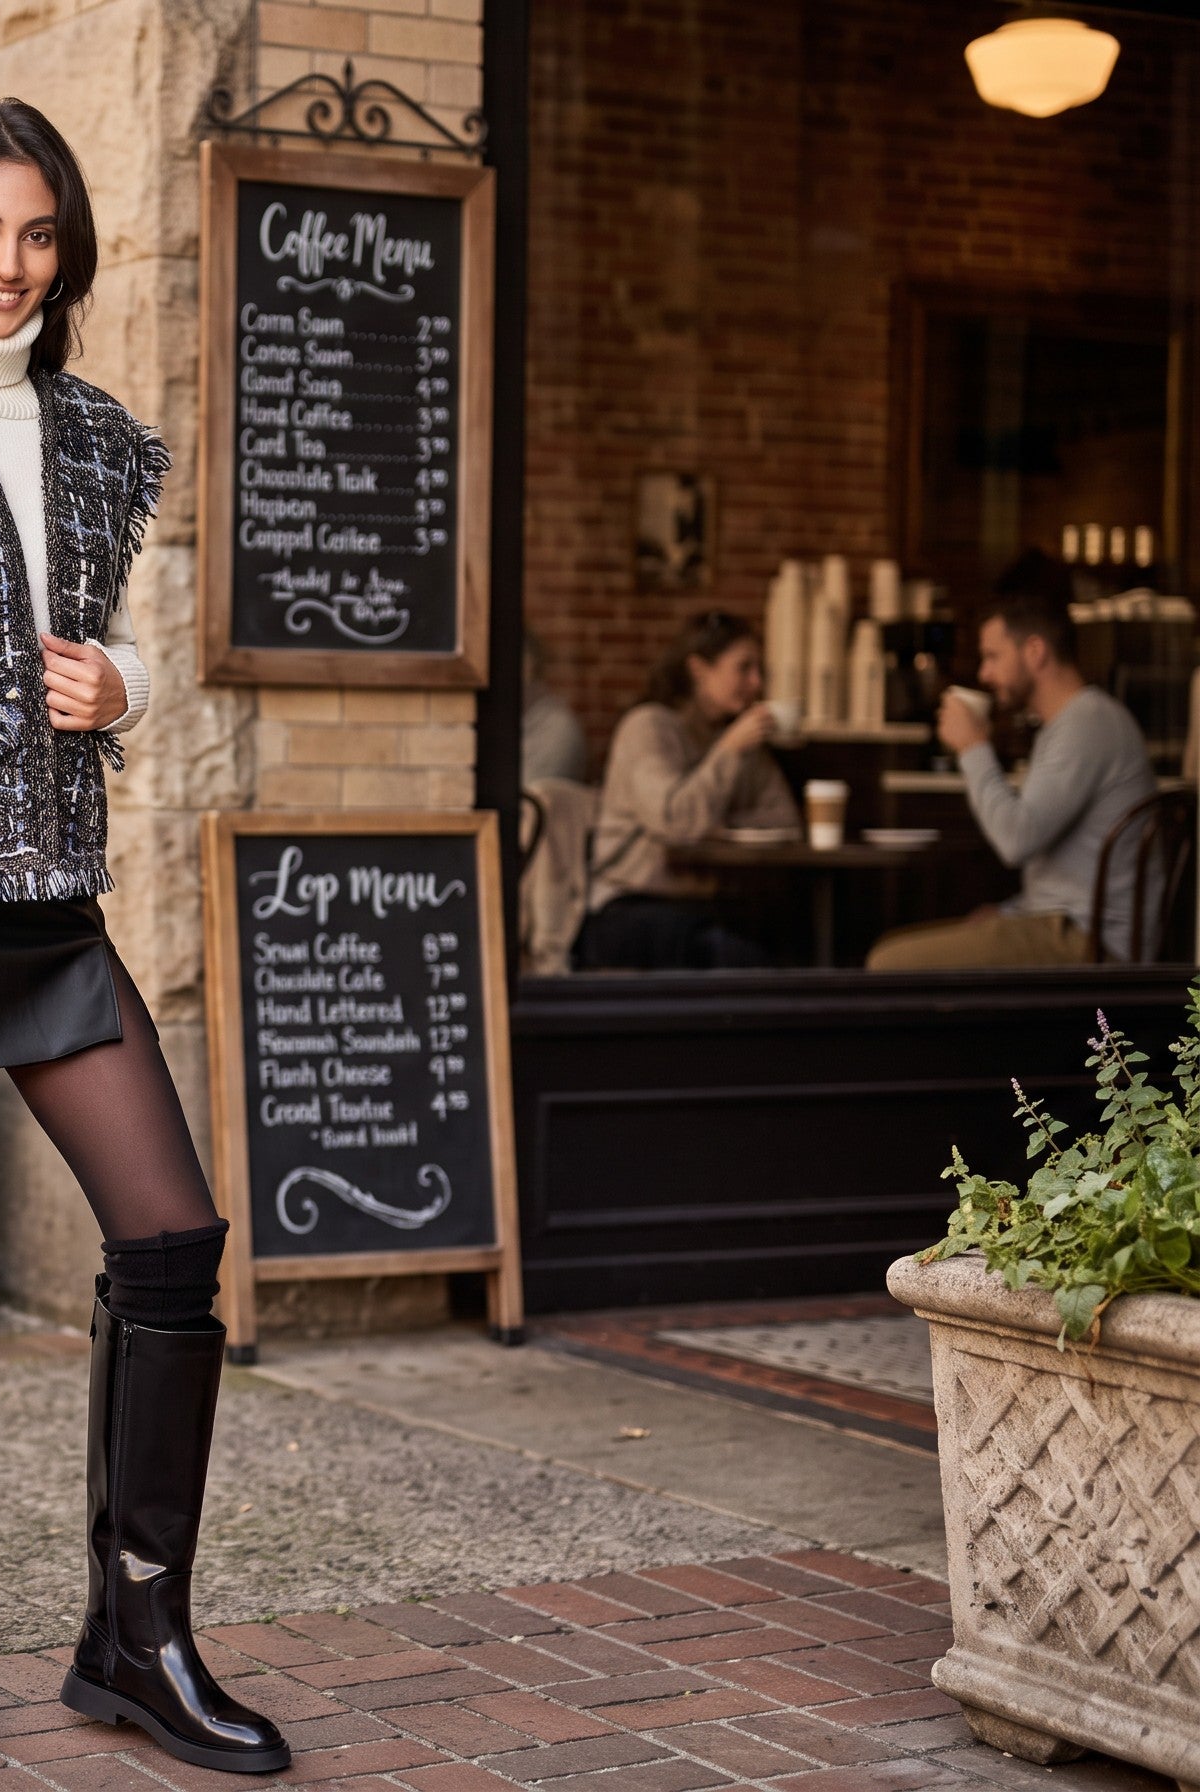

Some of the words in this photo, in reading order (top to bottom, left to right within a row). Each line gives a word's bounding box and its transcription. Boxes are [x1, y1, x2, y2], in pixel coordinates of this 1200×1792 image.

[259, 202, 350, 278] Coffee
[350, 212, 436, 285] Menu
[348, 866, 466, 919] Menu
[313, 931, 382, 964] Coffee
[318, 994, 404, 1025] Lettered
